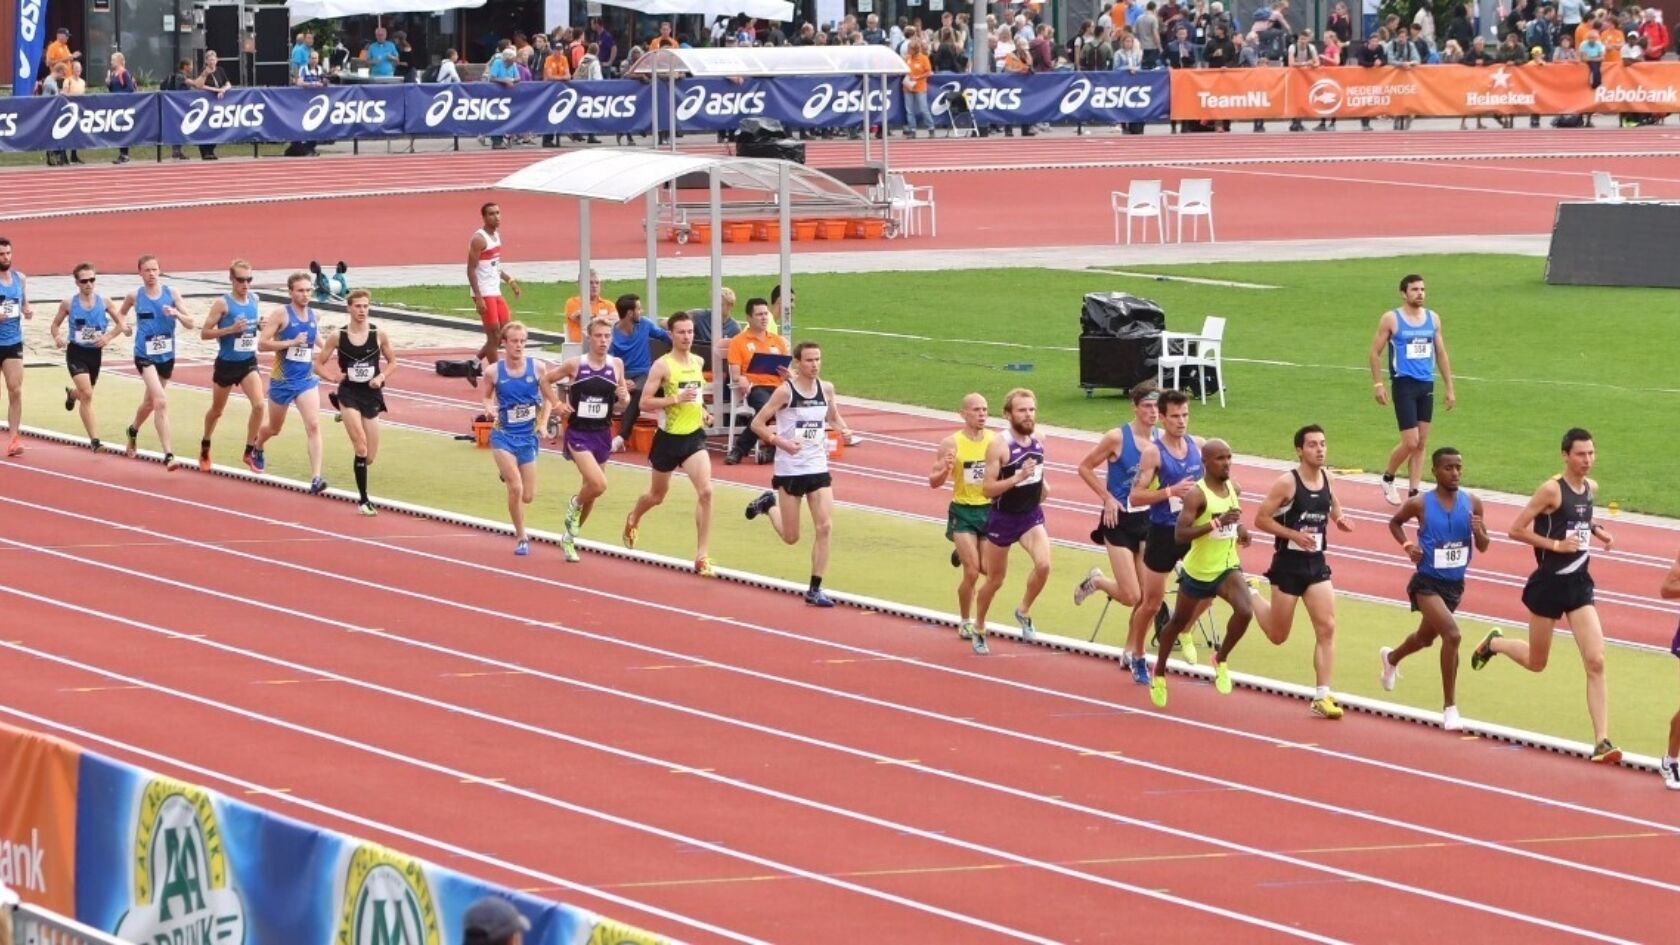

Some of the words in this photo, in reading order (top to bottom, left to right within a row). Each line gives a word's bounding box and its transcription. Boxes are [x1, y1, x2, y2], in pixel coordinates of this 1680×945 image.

[1346, 84, 1418, 96] NEDERLANDSE
[1594, 86, 1677, 103] Rabobank
[1197, 90, 1271, 109] TeamNL
[1346, 95, 1391, 107] LOTERIJ
[1466, 91, 1536, 106] Heineken
[802, 429, 818, 440] 407
